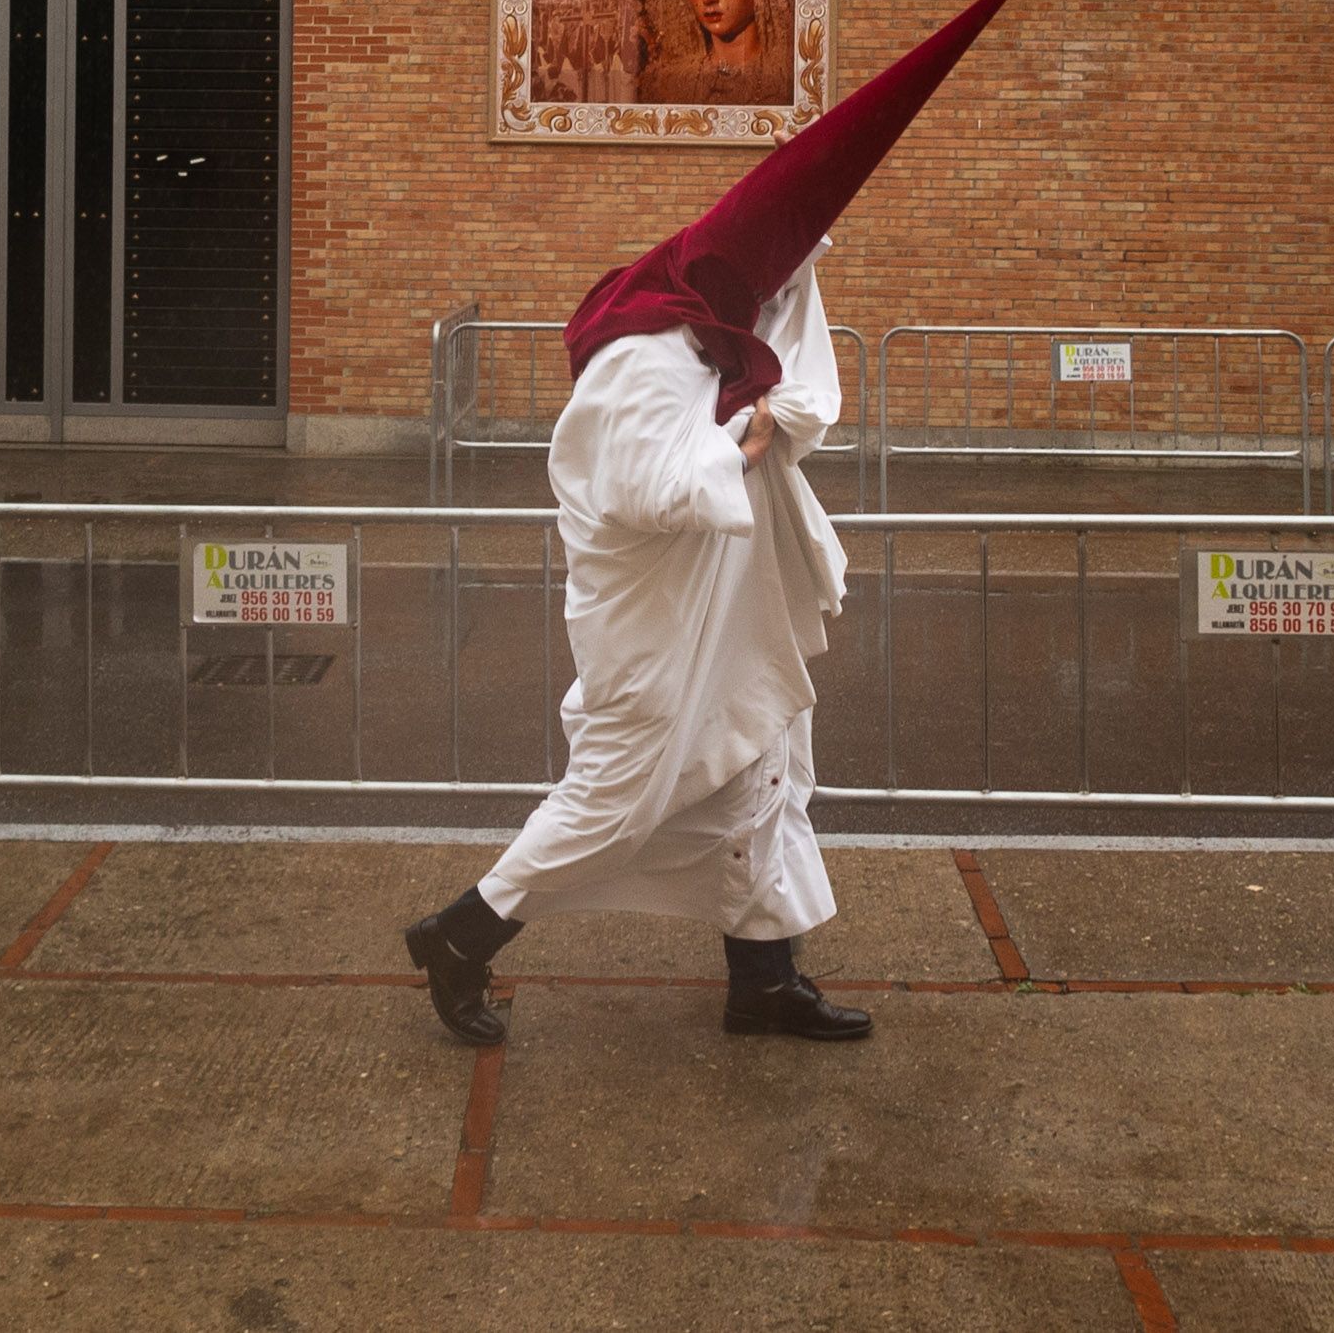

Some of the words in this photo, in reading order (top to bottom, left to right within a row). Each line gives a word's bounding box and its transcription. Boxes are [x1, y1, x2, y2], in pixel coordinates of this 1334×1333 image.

[1065, 346, 1109, 356] DURÁN
[204, 544, 300, 570] DURÁN
[1210, 554, 1312, 580] DURÁN
[207, 570, 335, 590] ALQUILERES
[241, 591, 267, 605] 956
[272, 591, 289, 605] 30
[294, 591, 311, 605] 70
[317, 591, 332, 605] 91
[241, 607, 267, 621] 856
[272, 608, 289, 621] 00
[295, 608, 312, 621] 16
[317, 608, 334, 621] 59
[1227, 604, 1244, 613] JEREZ
[1249, 601, 1277, 616] 956
[1282, 601, 1301, 616] 30
[1306, 602, 1325, 616] 70
[1249, 618, 1277, 632] 856
[1283, 619, 1301, 632] 00
[1307, 619, 1325, 633] 16
